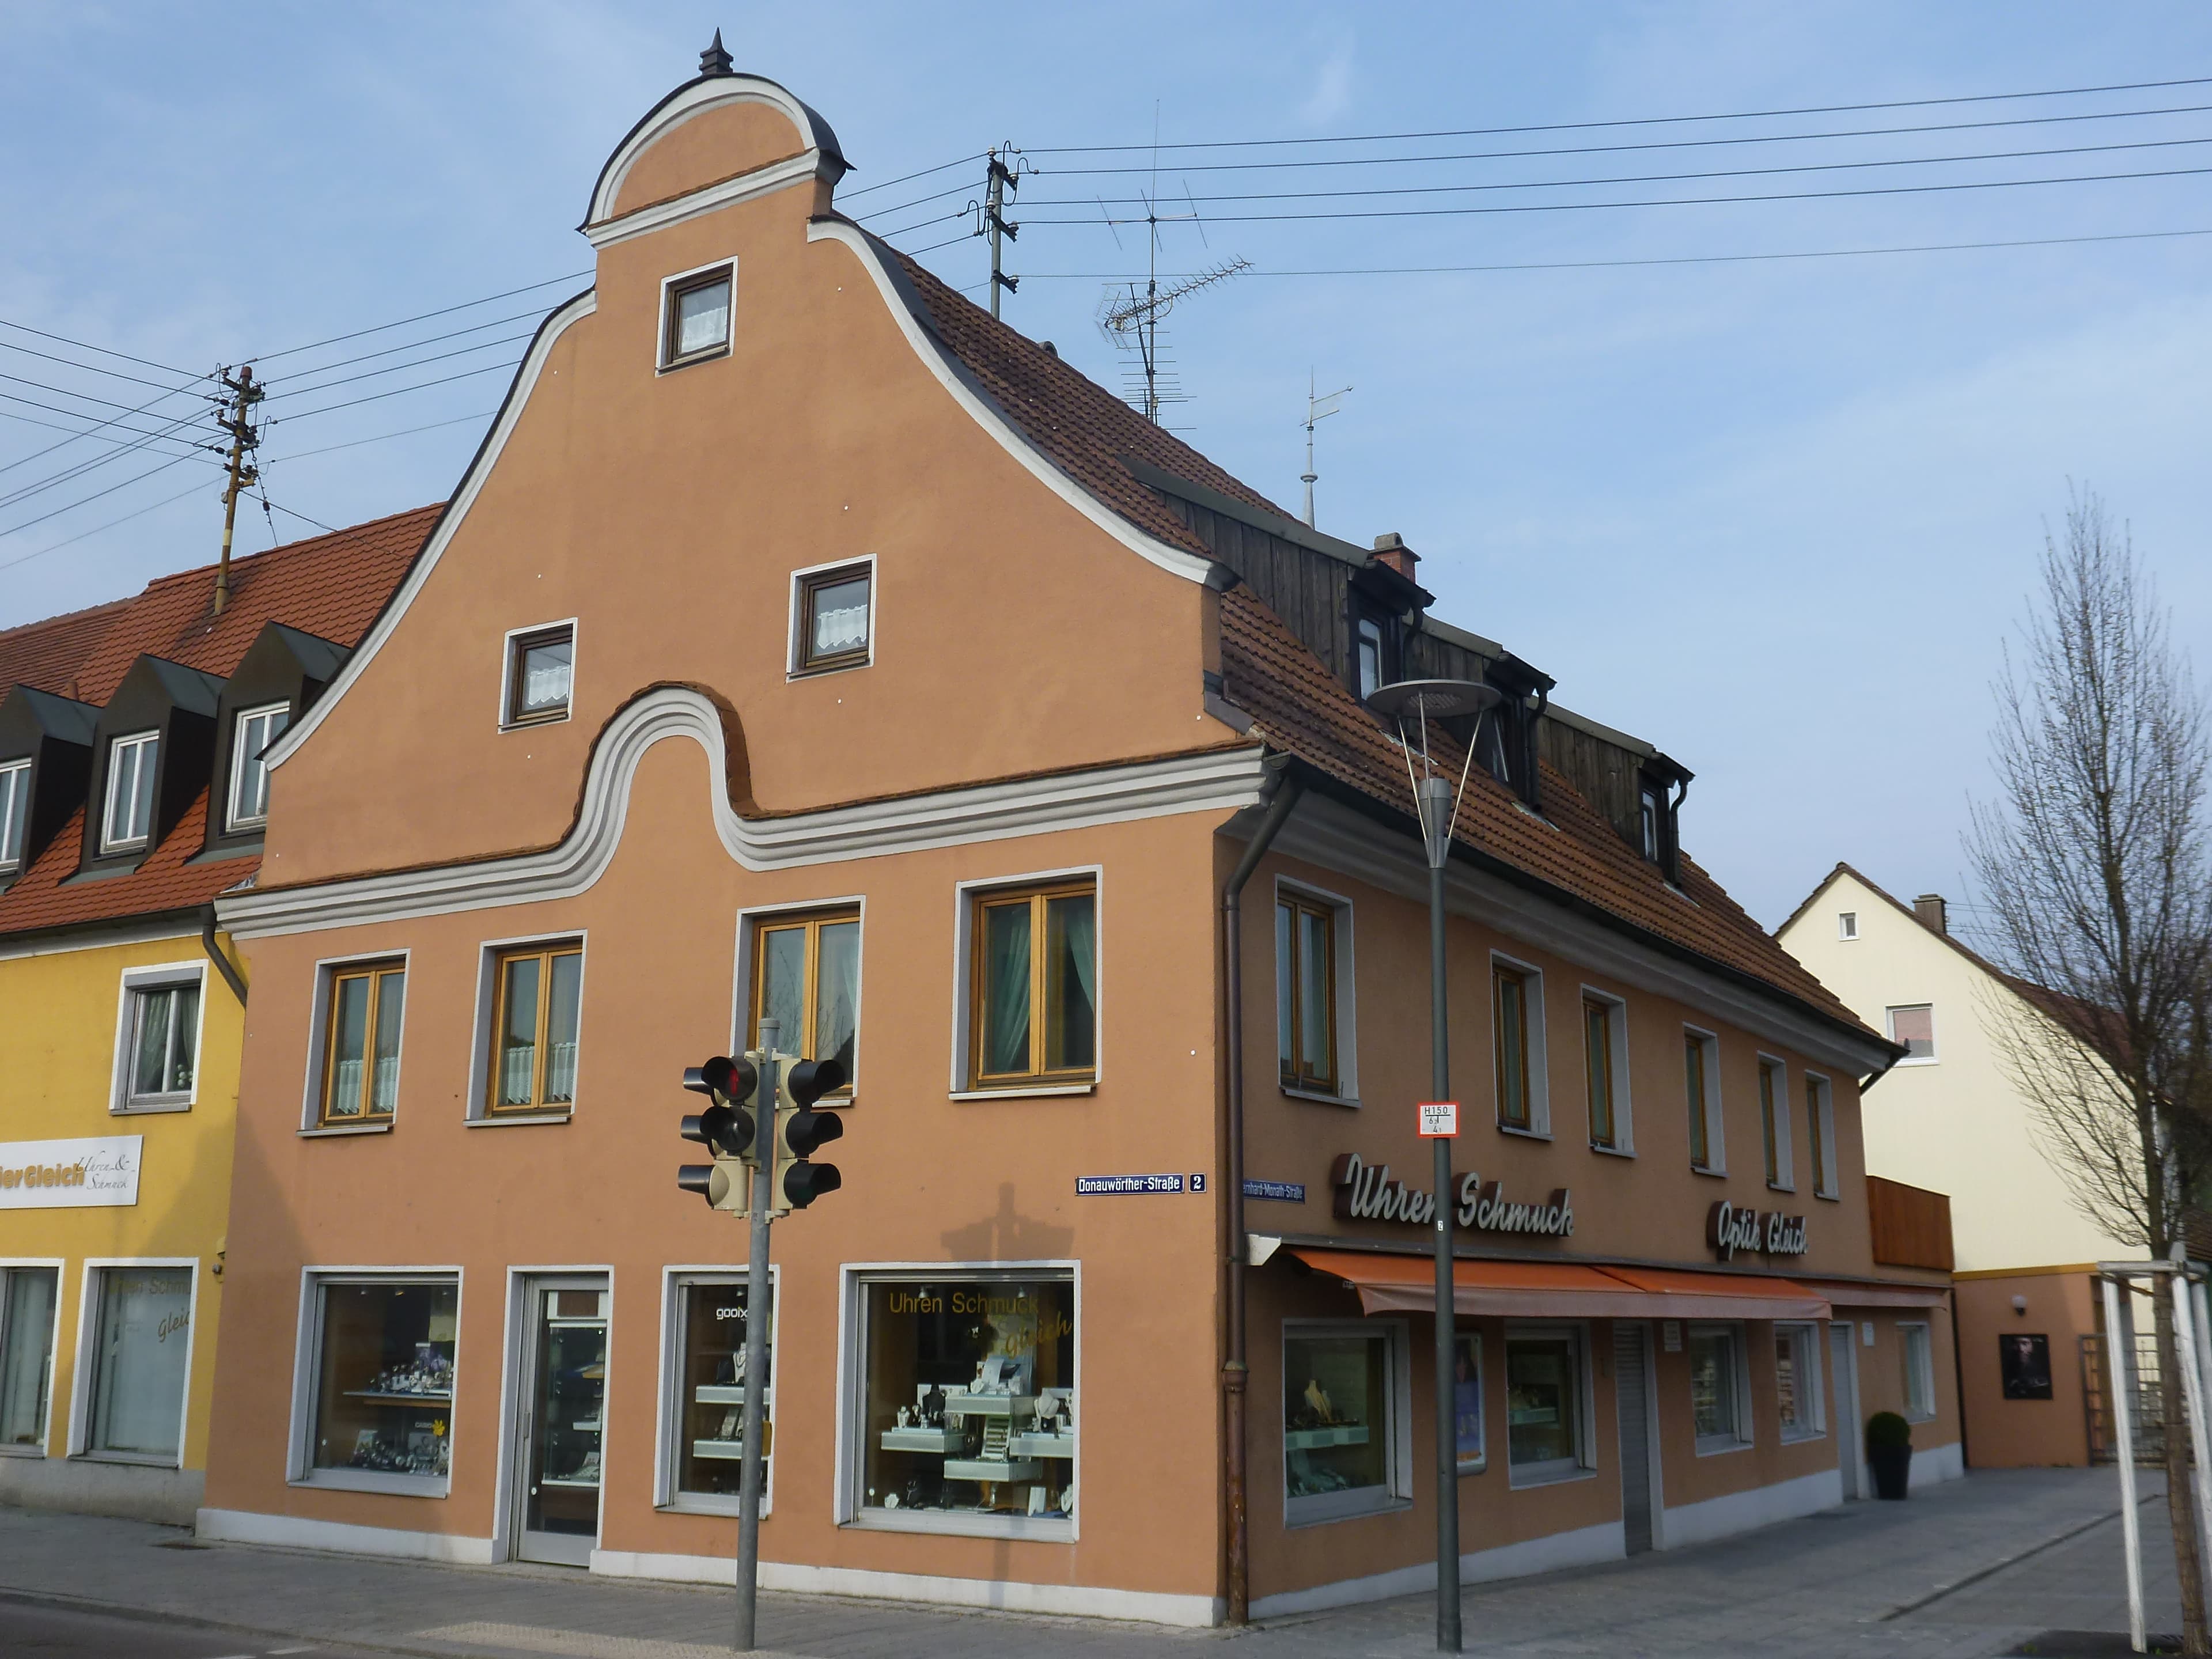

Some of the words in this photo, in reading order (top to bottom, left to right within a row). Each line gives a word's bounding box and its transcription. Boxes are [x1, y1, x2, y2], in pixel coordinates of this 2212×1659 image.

[1078, 1176, 1180, 1192] Donauwörther-Straße
[1194, 1176, 1202, 1190] 2
[1458, 1172, 1574, 1237] Schmuck
[1718, 1200, 1762, 1263] Optik
[889, 1292, 943, 1313] Uhren
[952, 1291, 1039, 1314] Schmuck
[716, 1306, 748, 1320] gooix
